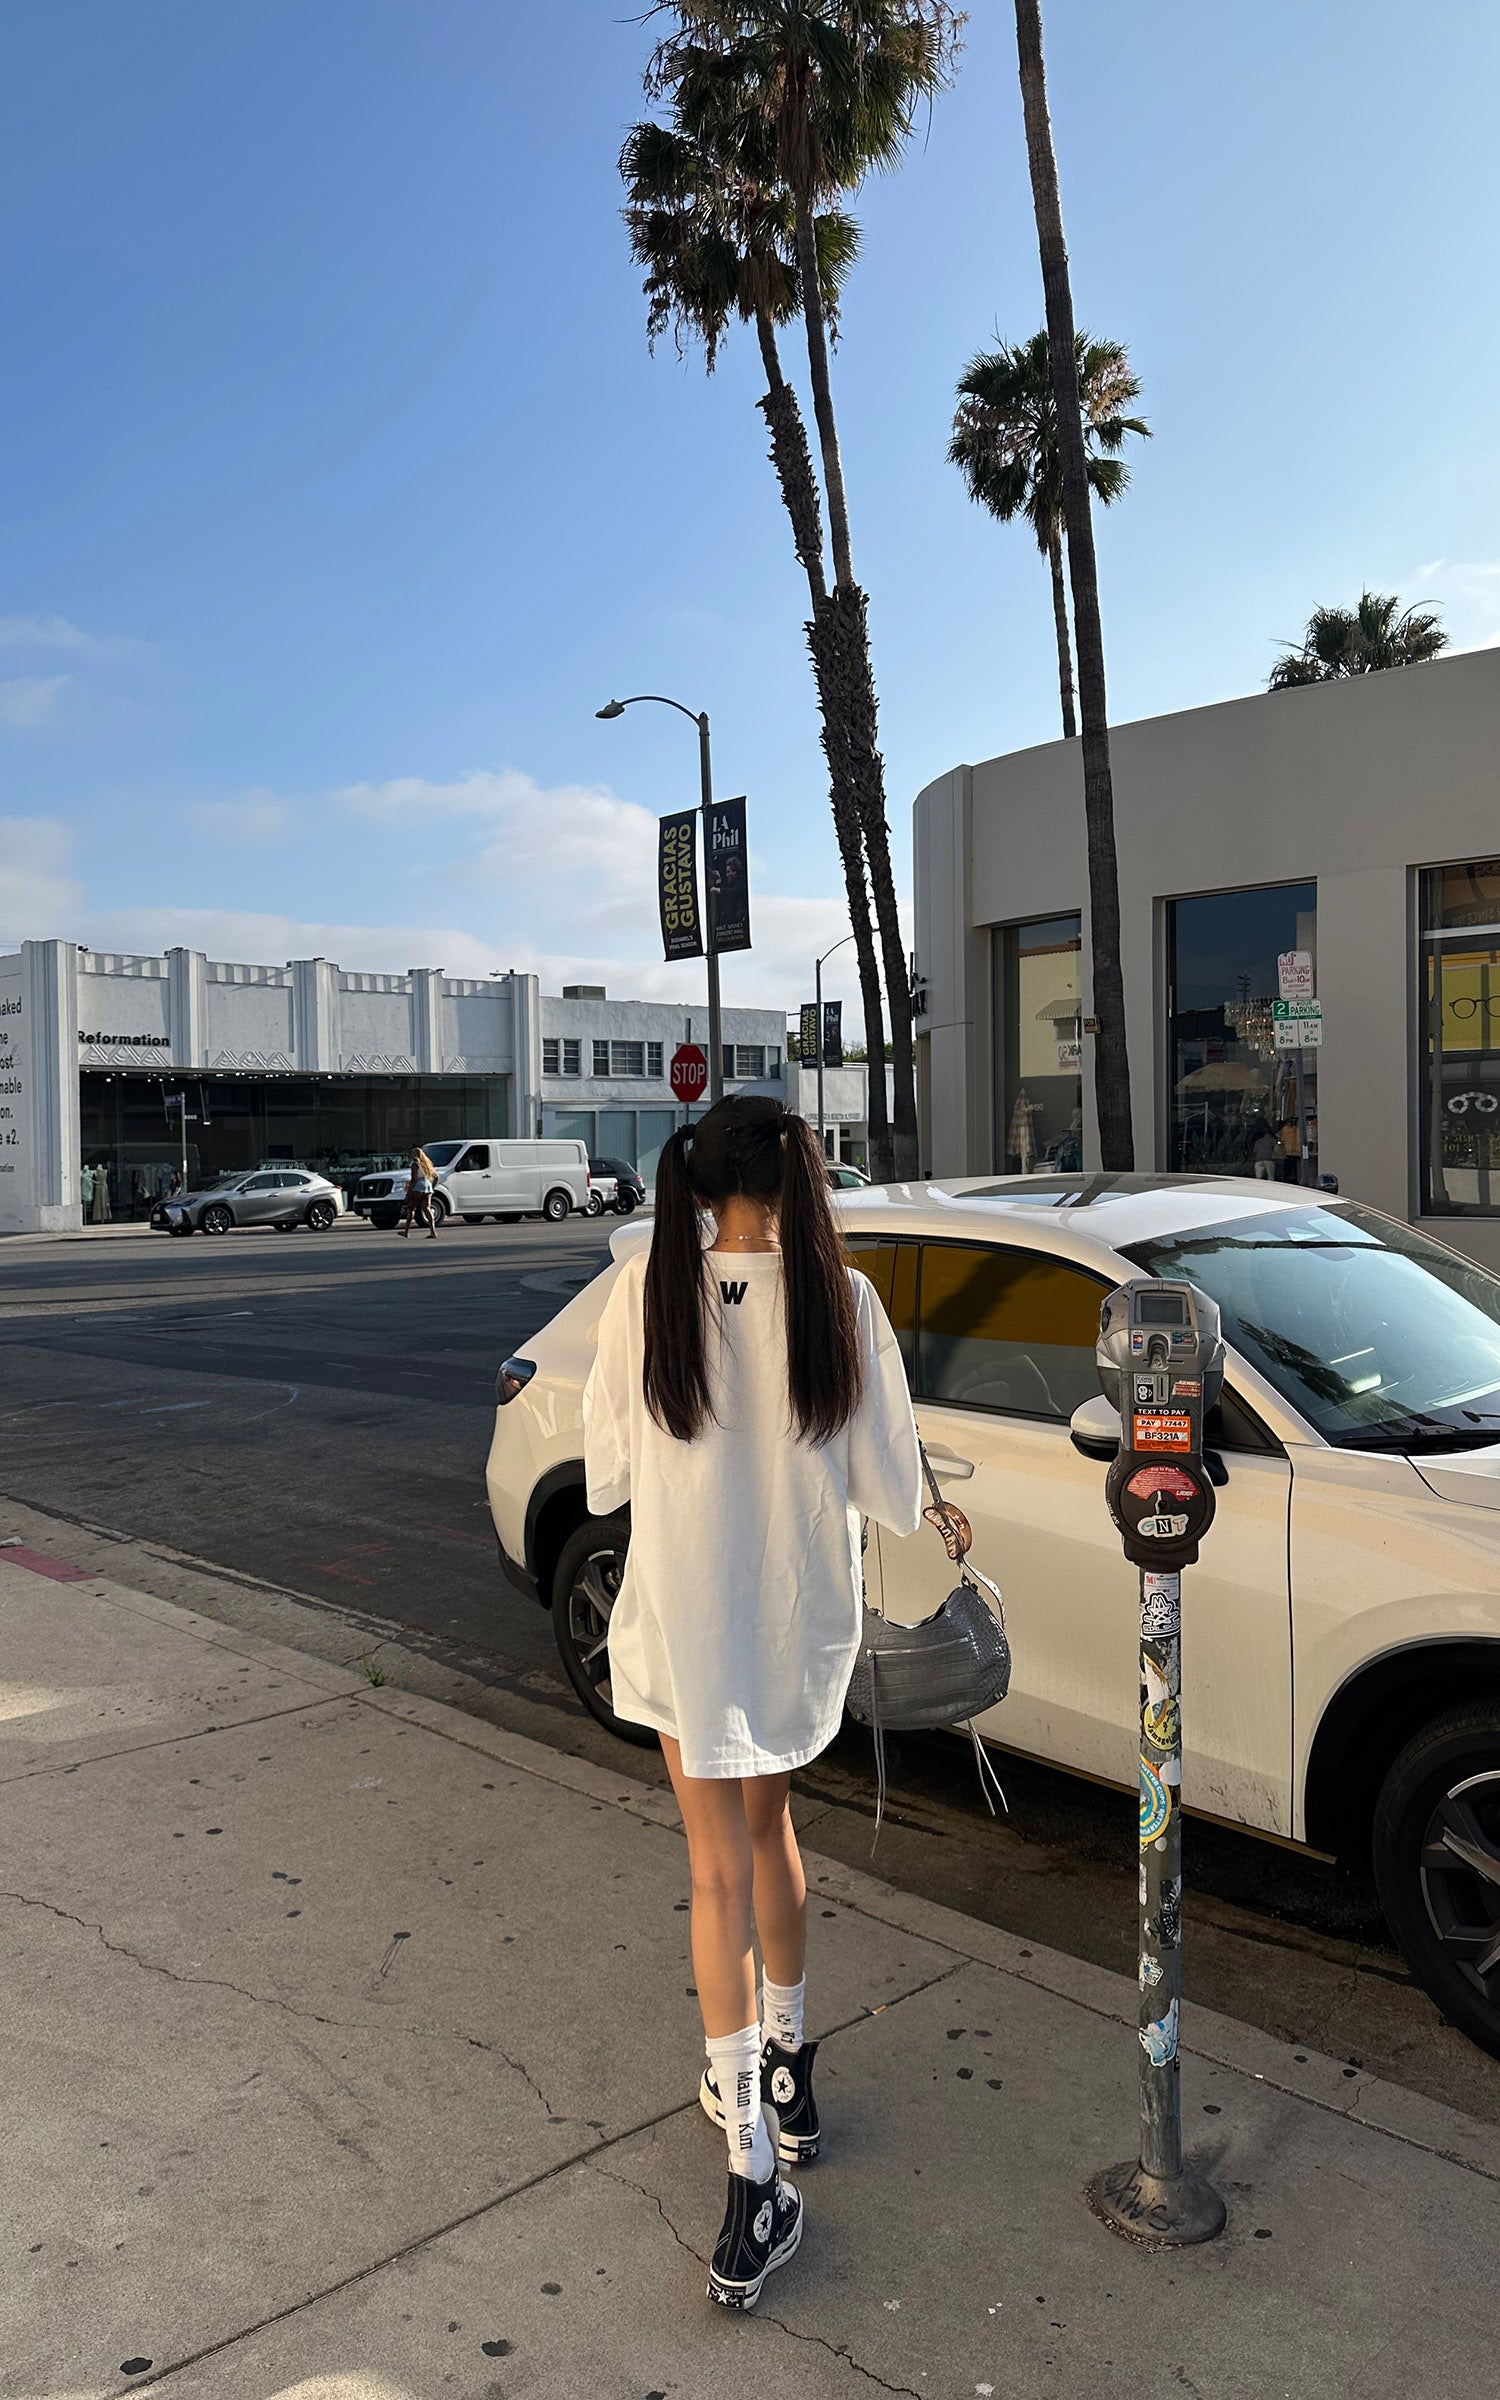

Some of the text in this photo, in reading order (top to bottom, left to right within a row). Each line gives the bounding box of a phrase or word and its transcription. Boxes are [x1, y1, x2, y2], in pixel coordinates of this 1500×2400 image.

[713, 815, 729, 832] LA
[712, 828, 739, 849] Phil
[663, 826, 679, 930] GRACIAS
[678, 823, 695, 928] GUSTAVO
[1281, 965, 1310, 976] PARKING
[0, 996, 22, 1016] aked
[1276, 1002, 1287, 1015] 2
[1290, 1005, 1320, 1016] PARKING
[78, 1030, 171, 1047] Reformation
[802, 1009, 810, 1056] GRACIAS
[809, 1008, 817, 1055] GUSTAVO
[673, 1062, 706, 1085] STOP
[720, 1281, 749, 1305] W
[1144, 1431, 1180, 1441] BF321A
[737, 2070, 755, 2151] Matin Kim
